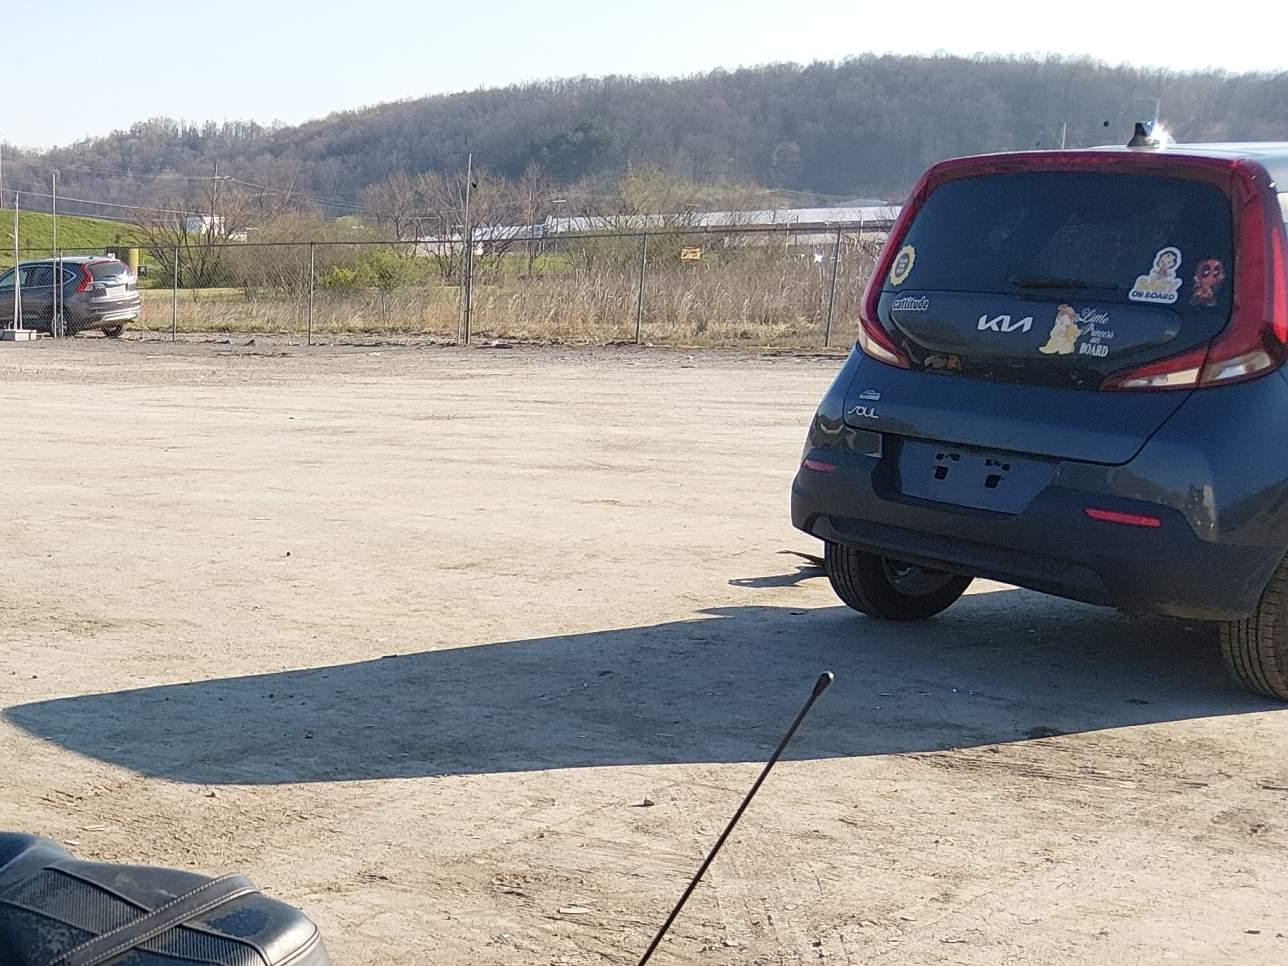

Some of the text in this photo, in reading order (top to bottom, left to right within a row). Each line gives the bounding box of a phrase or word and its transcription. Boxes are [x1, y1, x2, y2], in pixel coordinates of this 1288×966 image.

[1132, 290, 1175, 301] ON BOARD
[891, 296, 929, 311] cattitude
[1079, 307, 1110, 324] Little
[1079, 342, 1109, 358] BOARD
